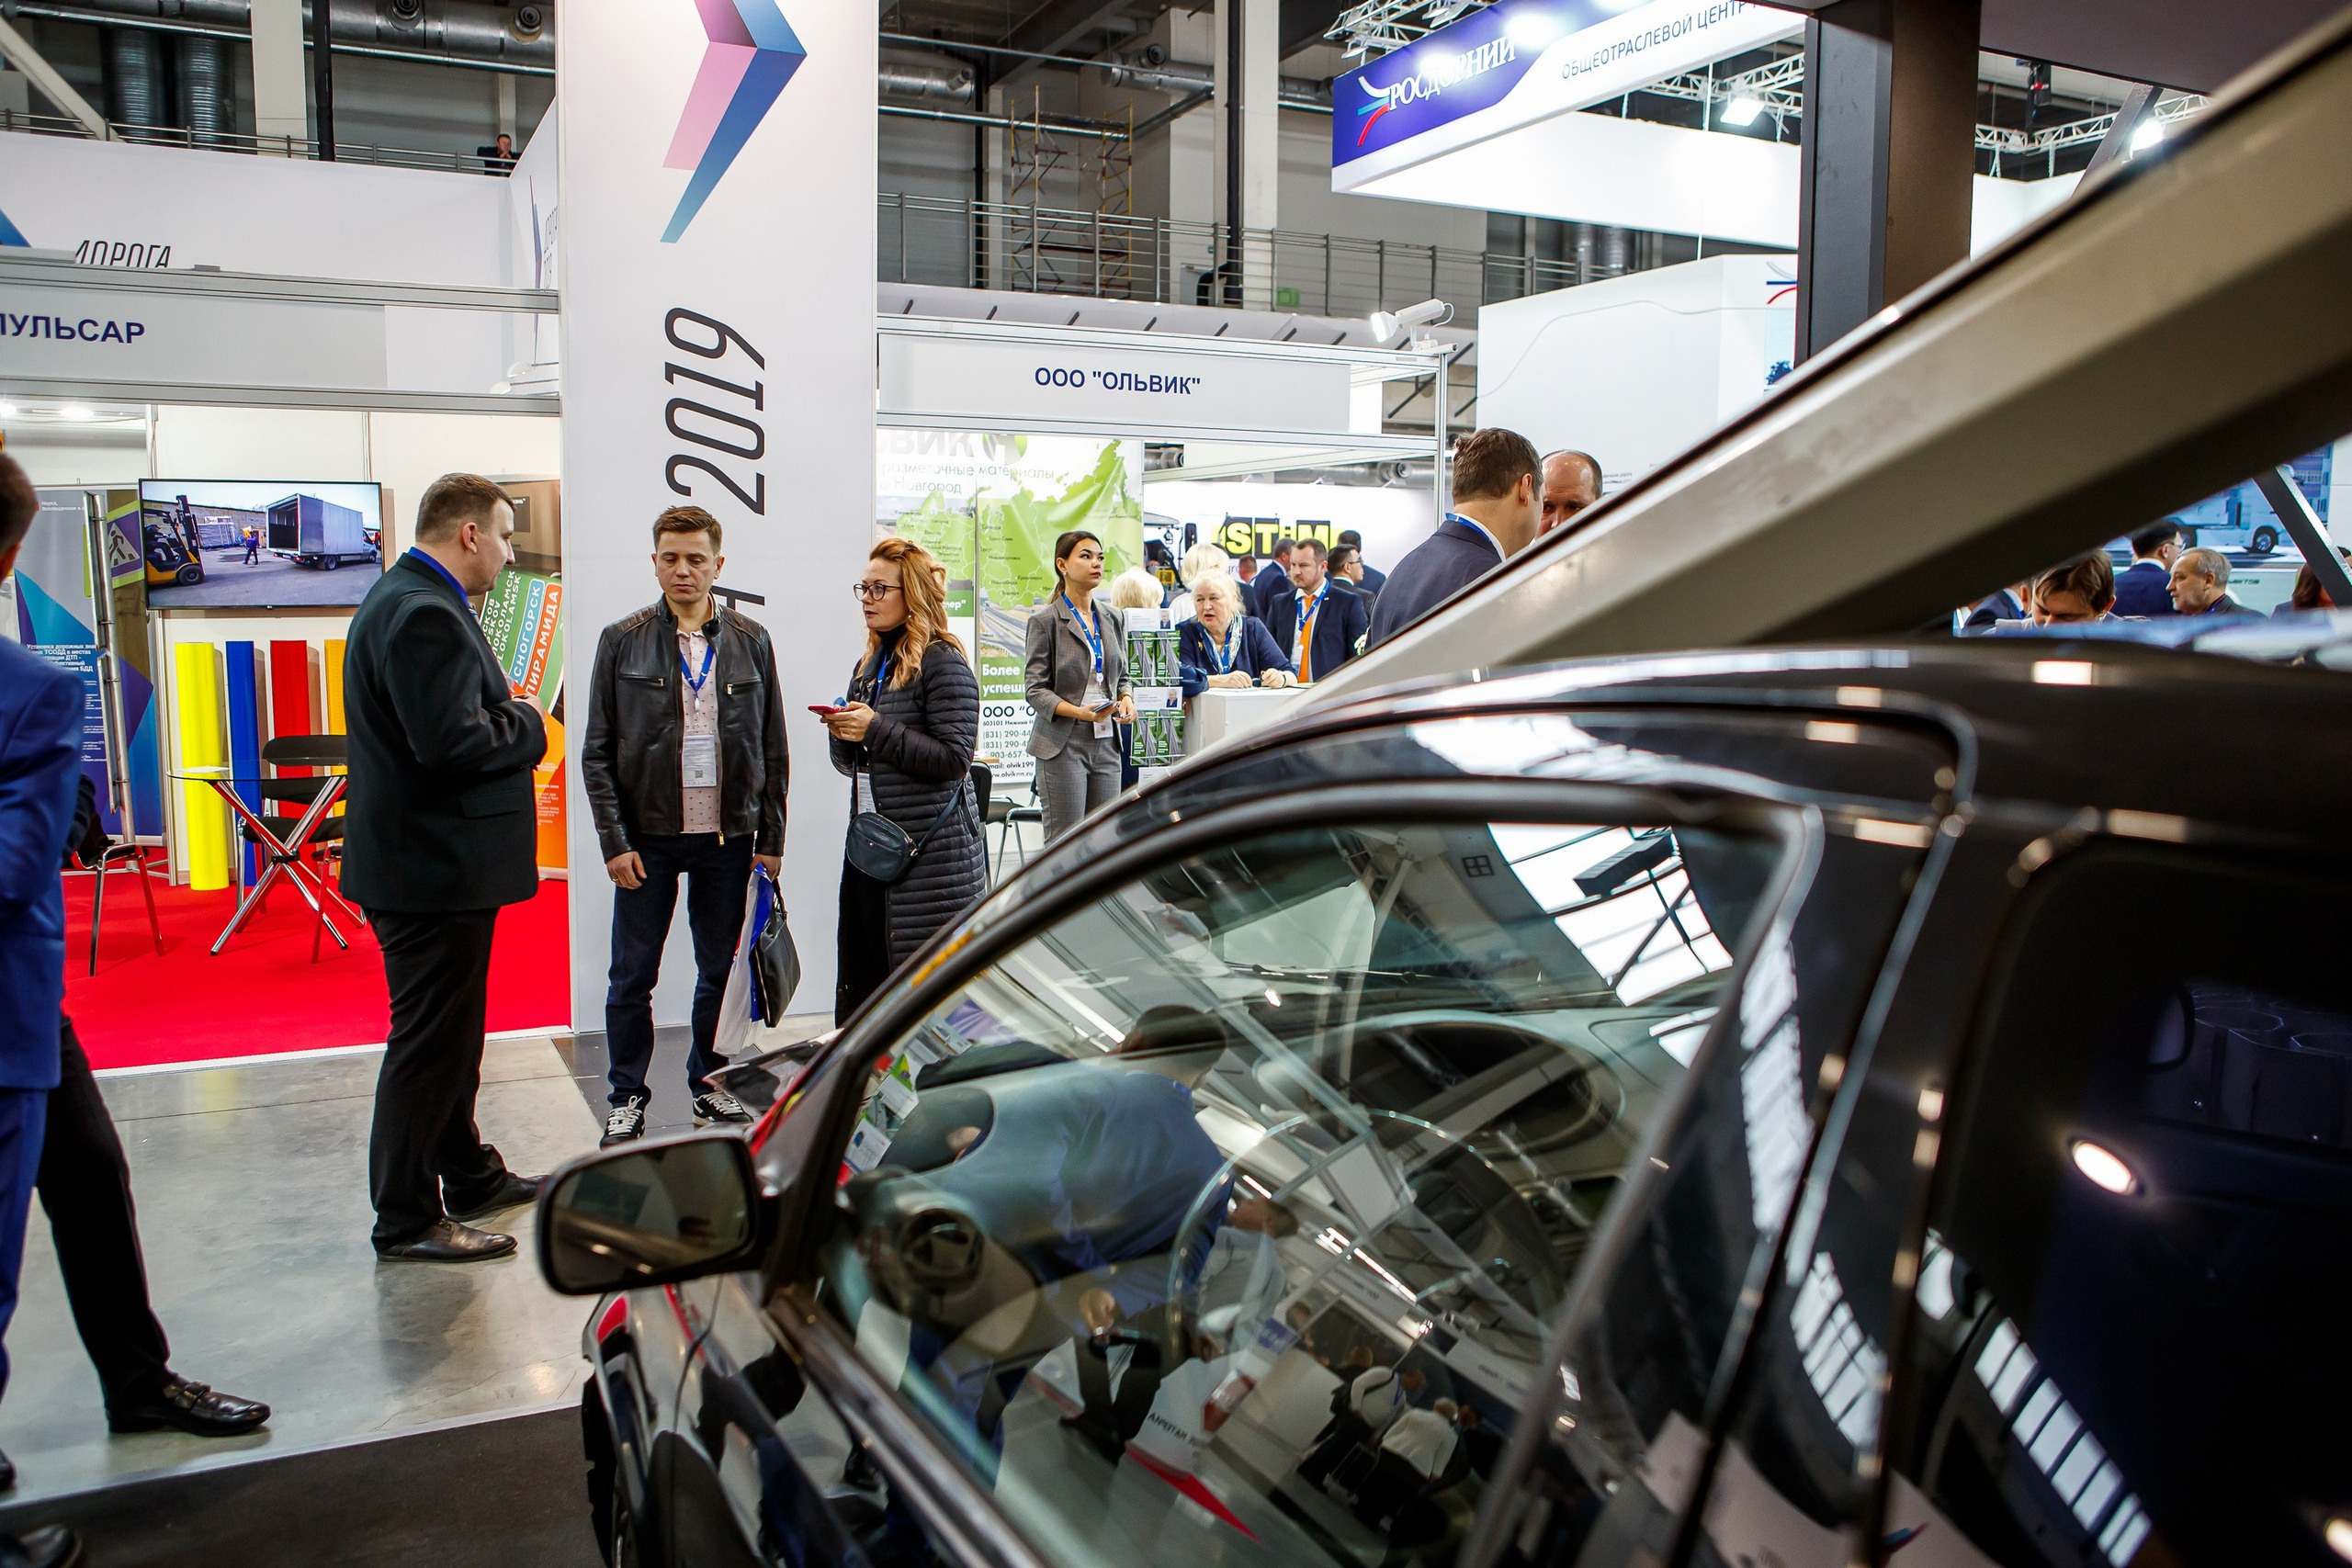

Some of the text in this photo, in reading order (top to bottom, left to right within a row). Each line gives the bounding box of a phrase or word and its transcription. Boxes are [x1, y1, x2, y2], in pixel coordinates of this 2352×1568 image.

[1563, 14, 1692, 79] ОБЩЕОТРАСЛЕВОЙ
[1389, 35, 1516, 110] РОСДОРНИИ
[1035, 367, 1202, 396] ООО "ОЛЬВИК"
[664, 307, 765, 516] 2019
[888, 432, 975, 457] ВИК
[894, 477, 962, 494] Новгород
[978, 466, 1055, 479] материалы
[482, 598, 495, 637] СКОВ
[514, 586, 540, 682] СНОГОРСК
[526, 591, 560, 695] ПИРАМИДА
[982, 663, 1021, 676] Более
[983, 705, 1036, 717] ООО "О
[983, 729, 1031, 739] (831) 290-44
[983, 740, 1002, 749] (831)
